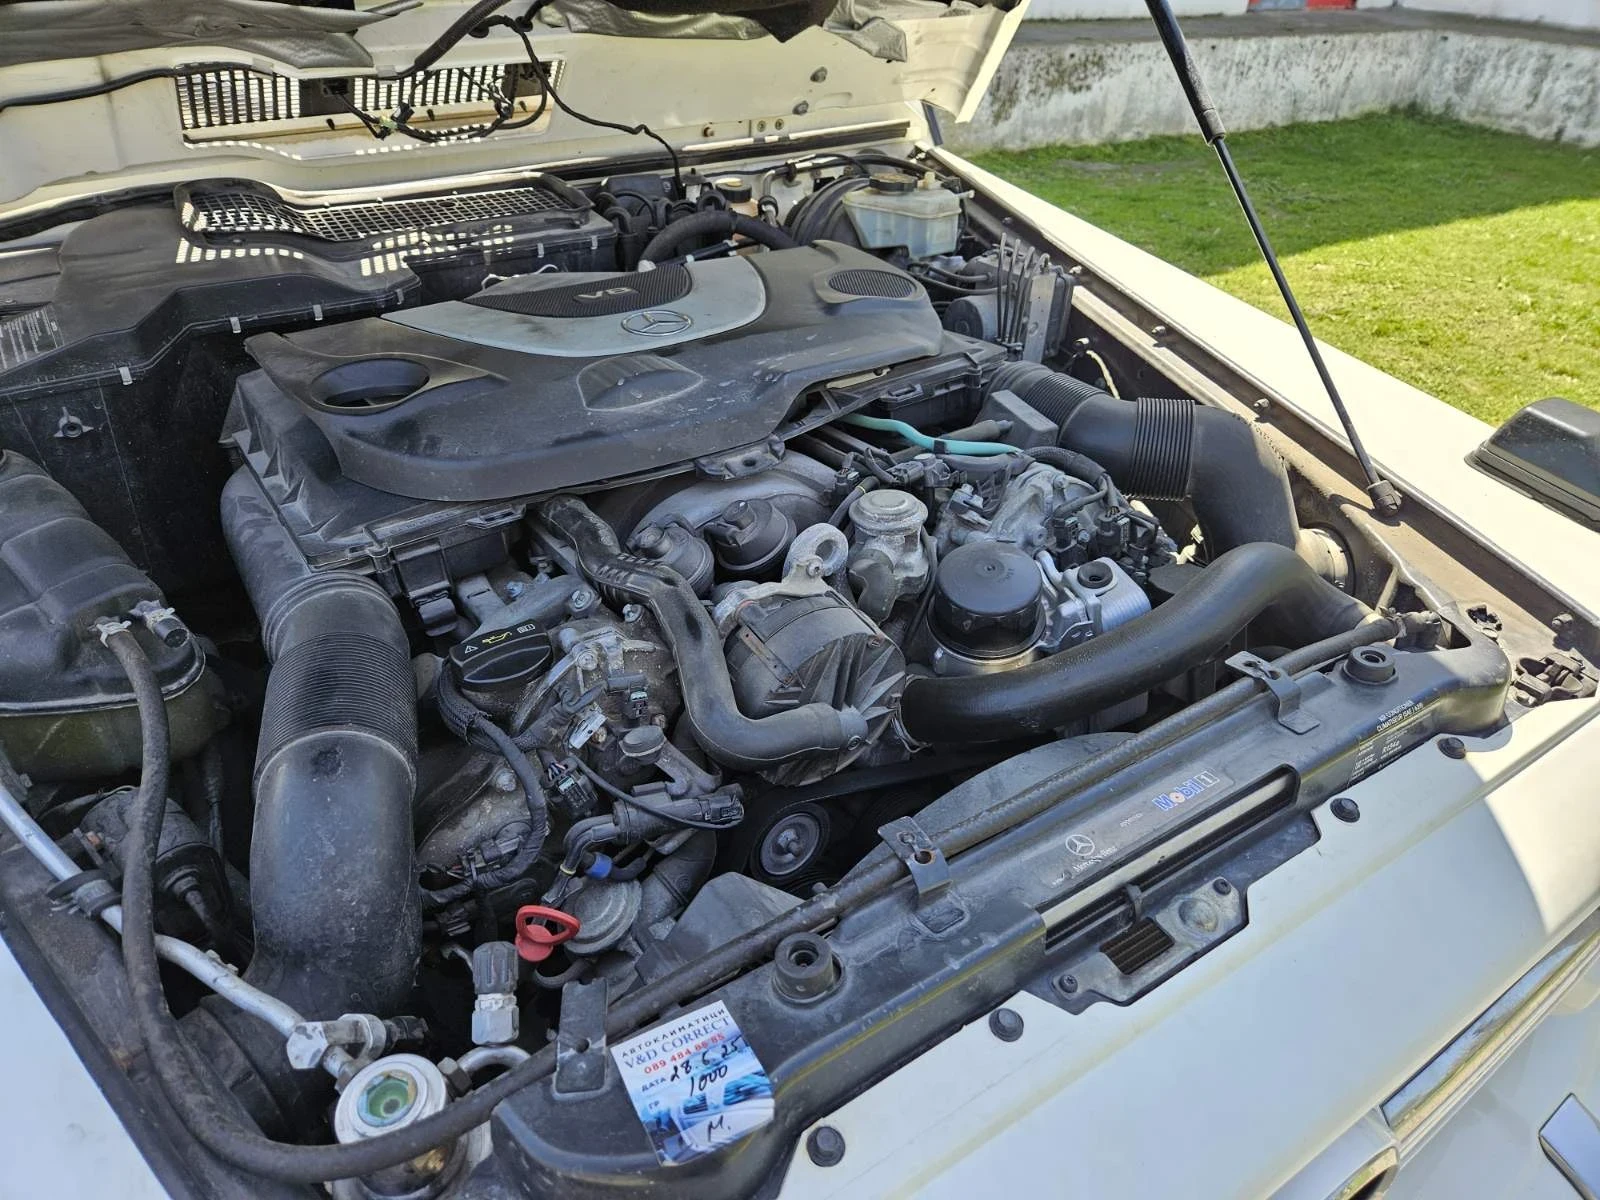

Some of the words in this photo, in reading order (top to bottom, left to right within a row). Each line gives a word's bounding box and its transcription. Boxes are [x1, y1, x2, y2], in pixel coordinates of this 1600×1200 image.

[1152, 776, 1205, 811] Mobil
[622, 1009, 725, 1058] АВТОКЛИМАТИЦИ
[624, 1049, 658, 1068] V&D
[661, 1016, 730, 1053] CORRECT
[644, 1059, 667, 1074] 089
[690, 1064, 728, 1097] 1000
